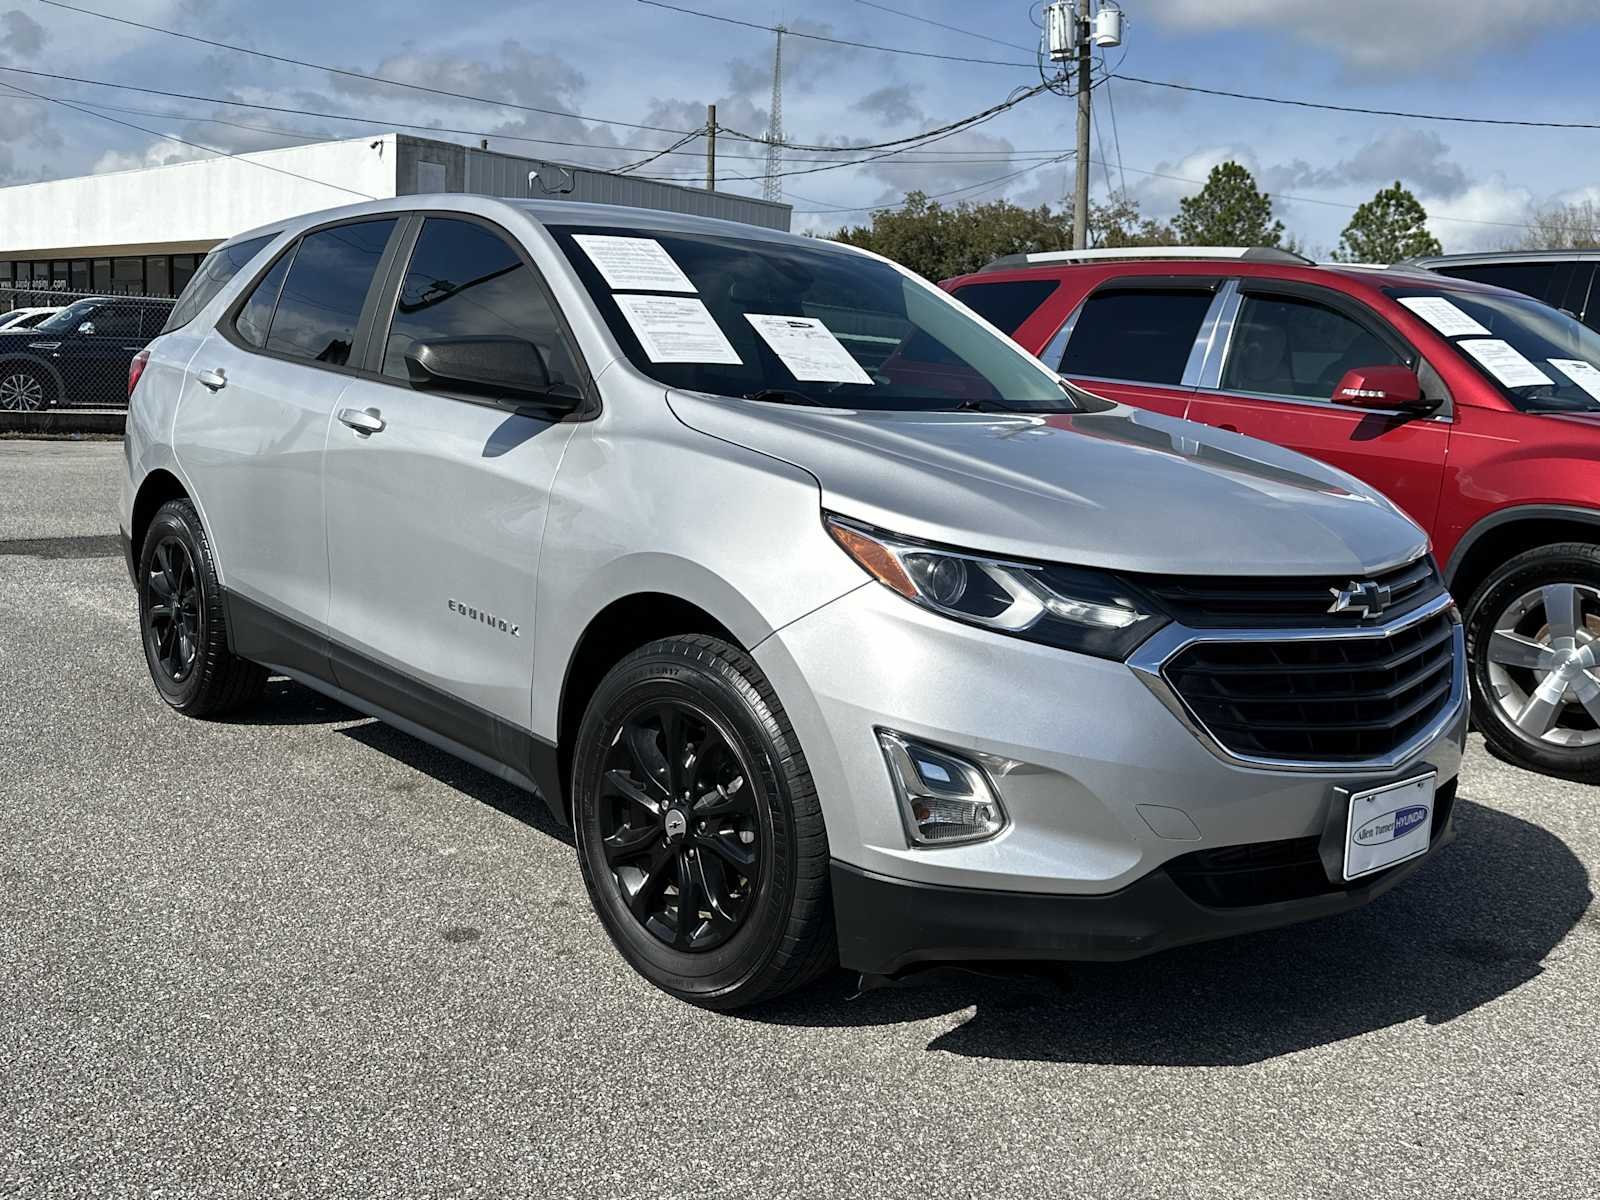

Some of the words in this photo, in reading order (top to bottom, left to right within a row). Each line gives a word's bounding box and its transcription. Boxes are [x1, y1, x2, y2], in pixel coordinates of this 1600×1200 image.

[448, 599, 520, 638] EQUINOX
[1357, 828, 1374, 841] Allen
[1375, 822, 1395, 836] Turner
[1395, 809, 1425, 829] HYUNDAI
